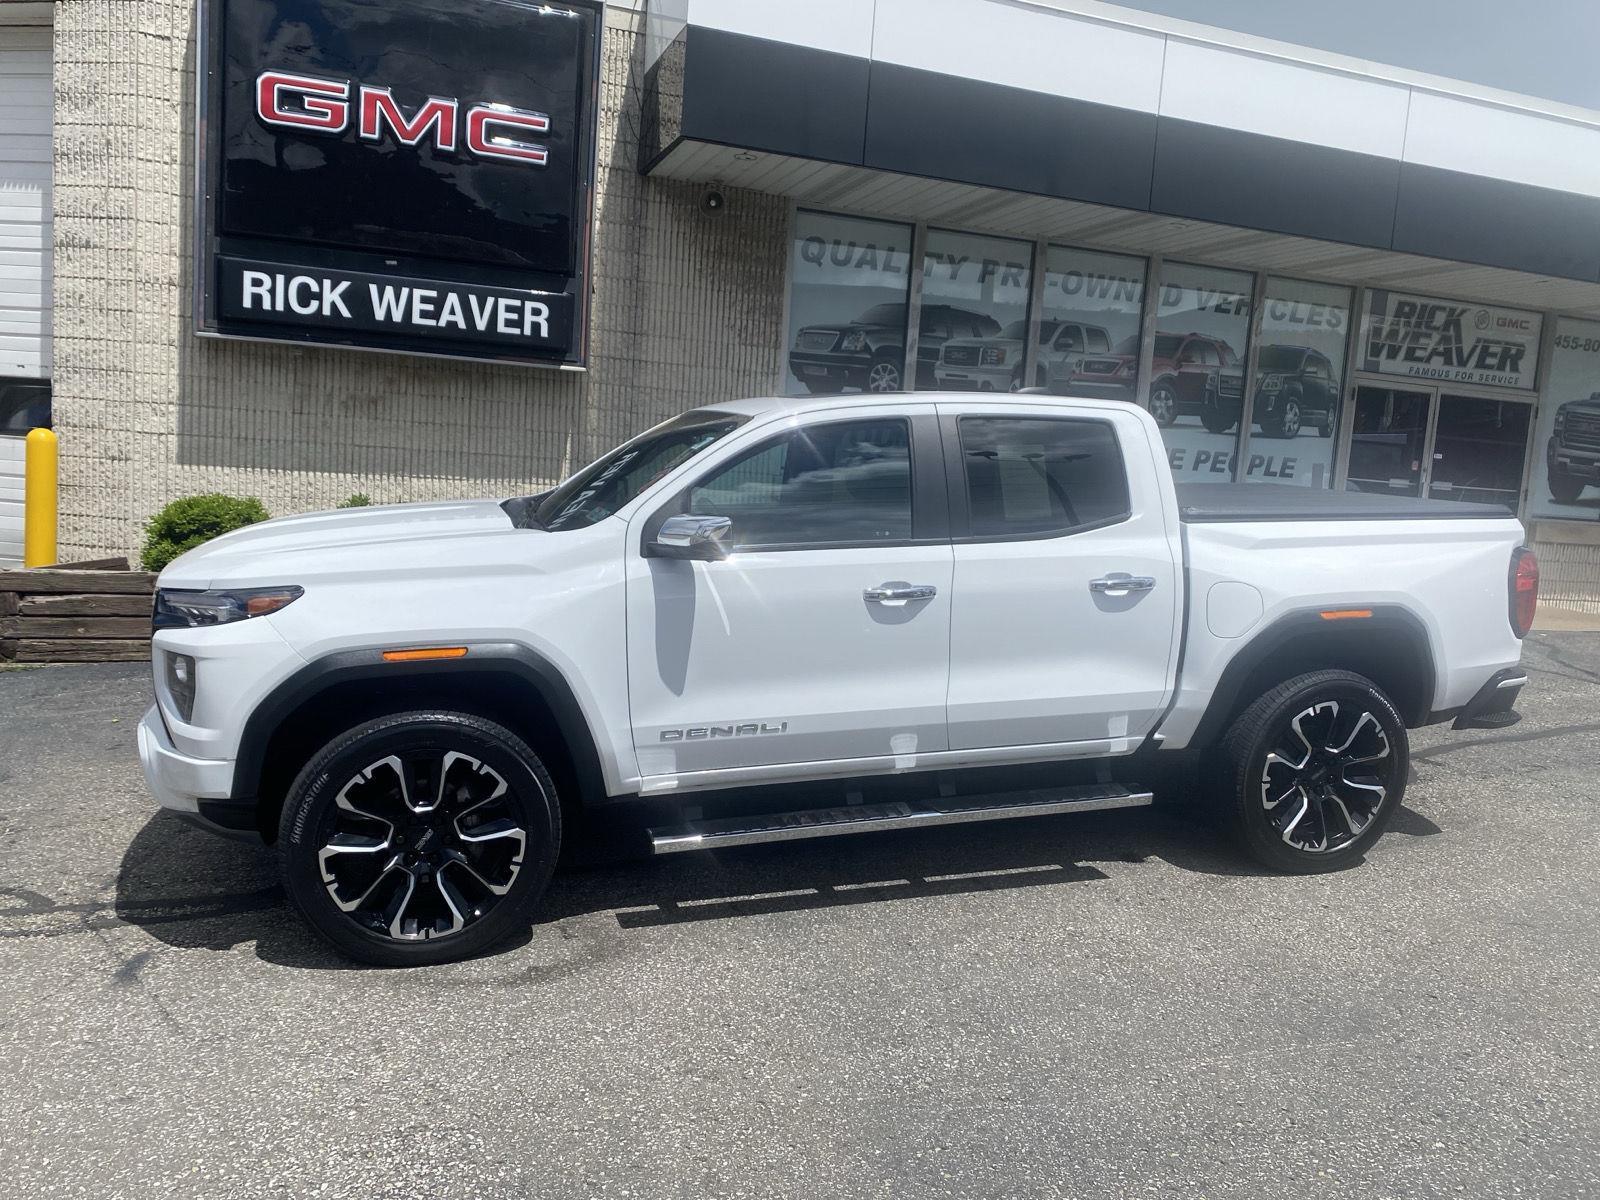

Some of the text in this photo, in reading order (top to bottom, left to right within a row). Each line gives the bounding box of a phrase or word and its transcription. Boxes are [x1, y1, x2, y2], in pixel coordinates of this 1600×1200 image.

[255, 70, 550, 166] GMC
[801, 235, 1343, 329] QUALTY PR-OWND VEHCLES
[241, 269, 550, 338] RICK WEAVER
[1389, 301, 1471, 332] RICK
[1496, 318, 1531, 331] GMC
[1369, 325, 1527, 374] WEAVER
[1408, 366, 1520, 386] FAMOUS FOR SERVICE
[1191, 450, 1298, 479] PEPLE
[659, 721, 789, 743] DENALI
